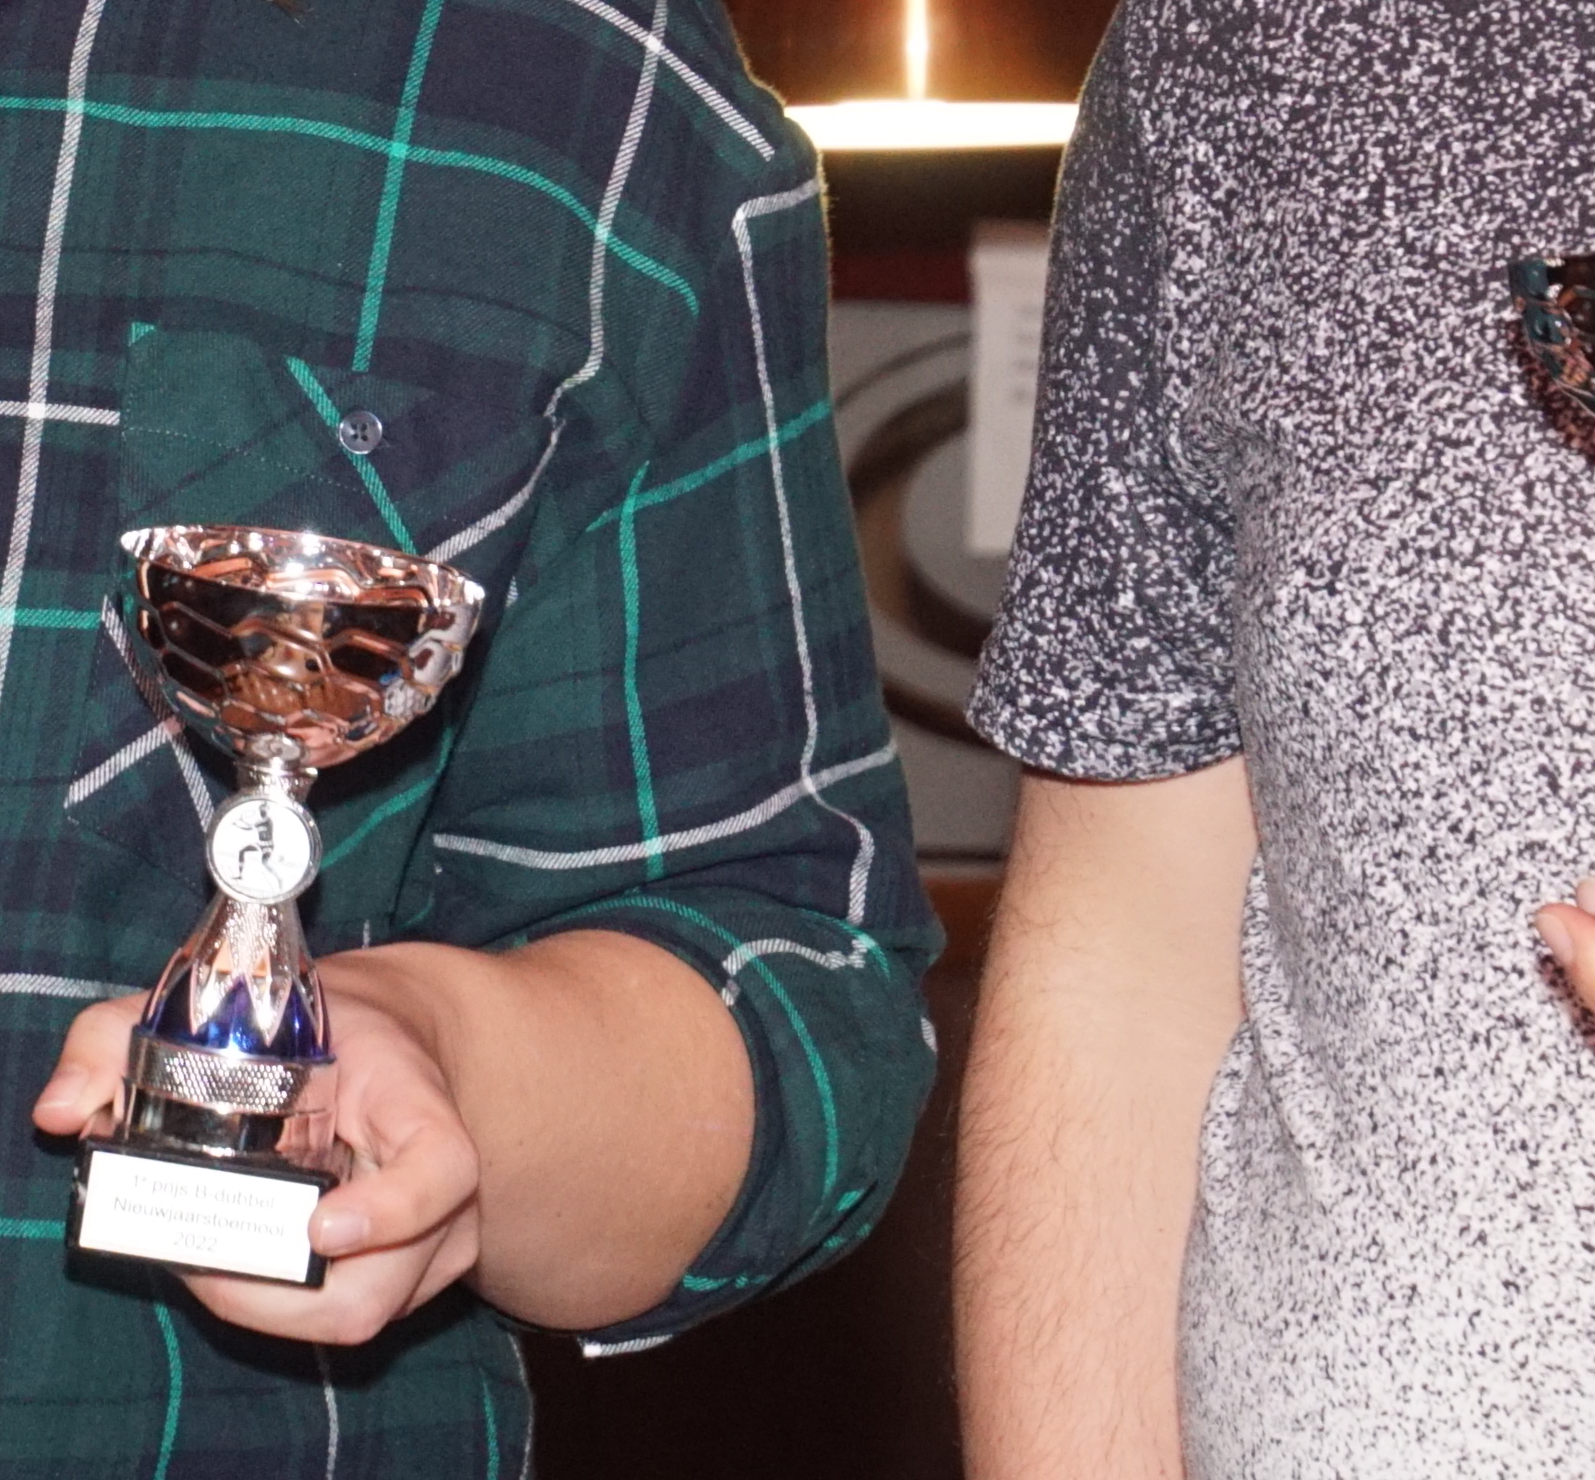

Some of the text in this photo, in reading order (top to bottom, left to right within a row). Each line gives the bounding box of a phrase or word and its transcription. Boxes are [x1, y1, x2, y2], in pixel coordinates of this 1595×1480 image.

[152, 1180, 189, 1199] prijs
[195, 1184, 275, 1210] B-dubbel
[173, 1232, 218, 1252] 2022
